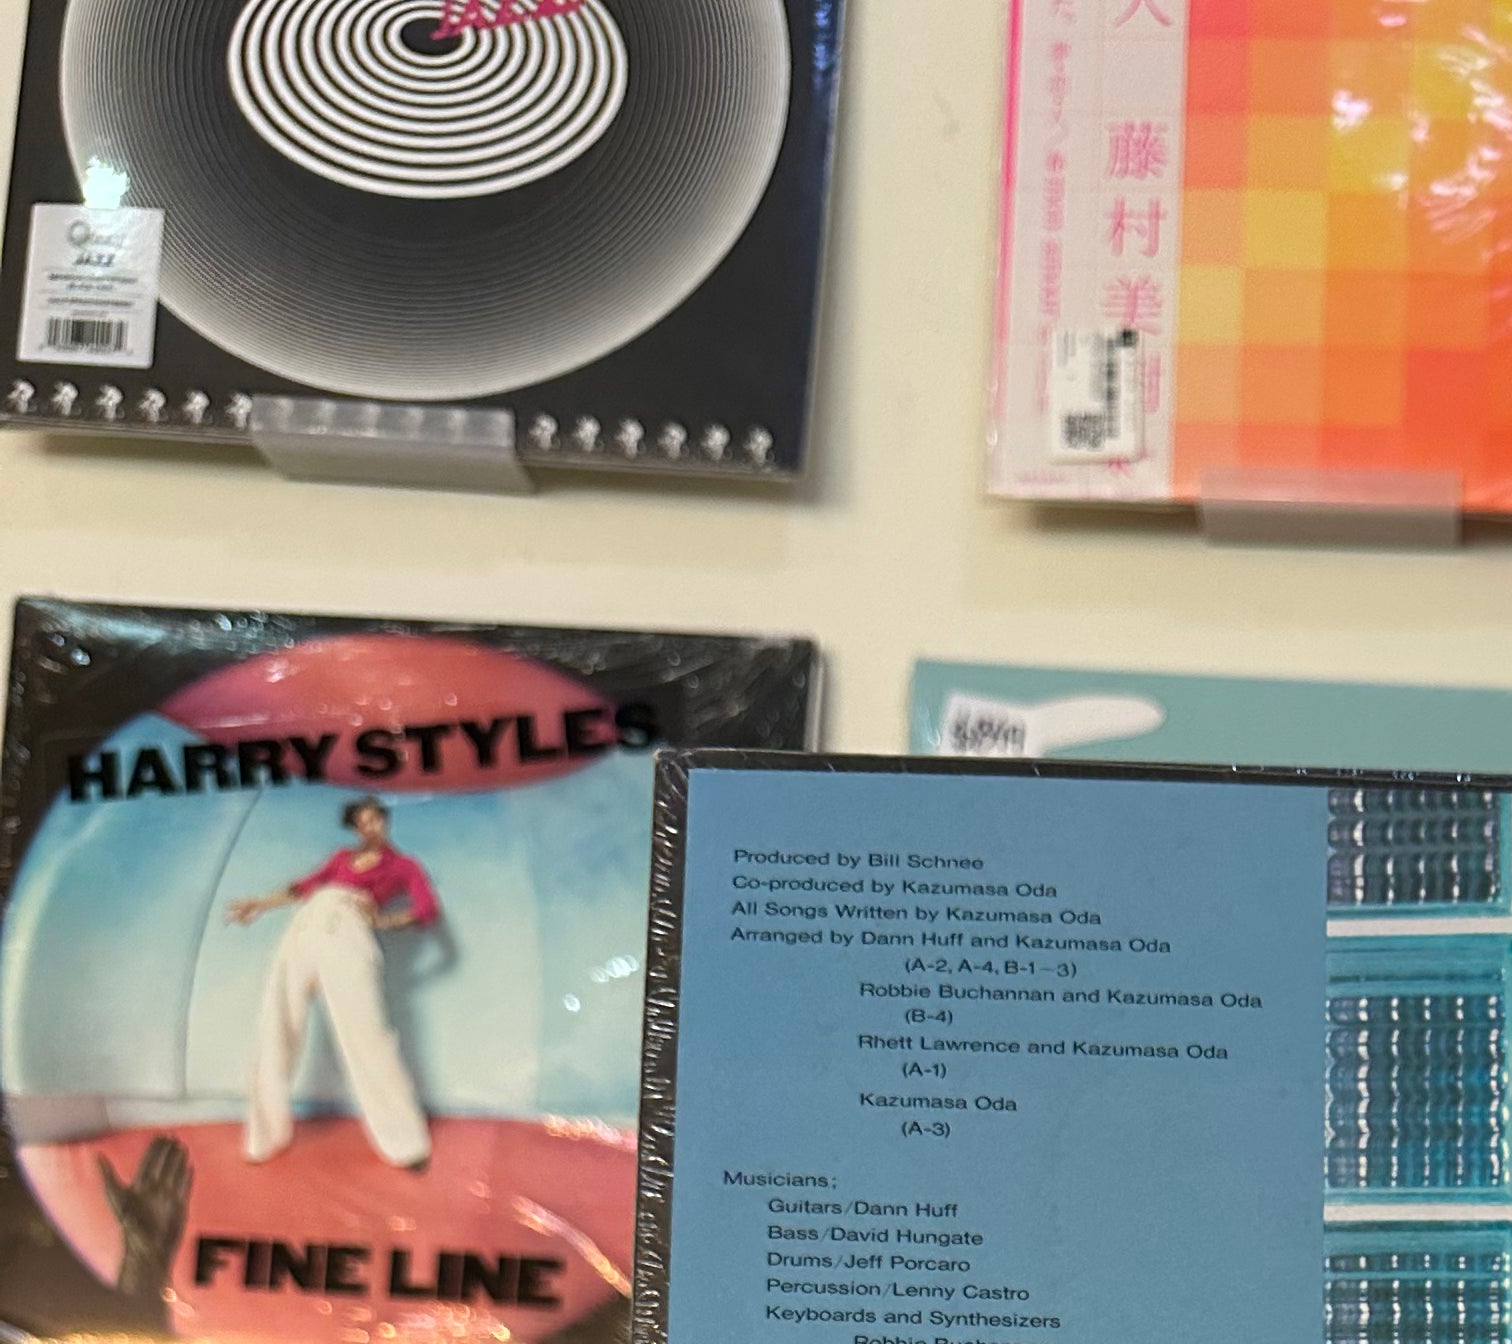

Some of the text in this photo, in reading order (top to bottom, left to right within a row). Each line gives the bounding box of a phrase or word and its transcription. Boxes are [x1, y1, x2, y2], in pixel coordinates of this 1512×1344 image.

[64, 701, 662, 800] HARRY STYLES
[733, 848, 985, 871] Produced by Bill Schnee
[731, 874, 1058, 899] Co-produced by Kazumasa Oda
[730, 899, 1102, 926] All Songs Written by Kazumasa Oda
[729, 926, 1172, 954] Arranged by Dann Huff and Kazumasa Oda
[859, 981, 1263, 1009] Robbie Buchannan and Kazumasa Oda
[903, 1007, 954, 1027] (B-4)
[857, 1033, 1229, 1060] Rhett Lawrence and Kazumasa Oda
[900, 1060, 948, 1080] (A-1)
[858, 1092, 1018, 1112] Kazumasa Oda
[900, 1119, 951, 1140] (A-3)
[722, 1169, 837, 1191] Musicians;
[914, 1201, 959, 1219] Huff
[895, 1228, 985, 1248] Hungate
[193, 1237, 563, 1309] FINE LINE
[889, 1254, 971, 1273] Porcaro
[961, 1283, 1031, 1302] Castro
[765, 1304, 1062, 1330] Keyboards and Synthesizers
